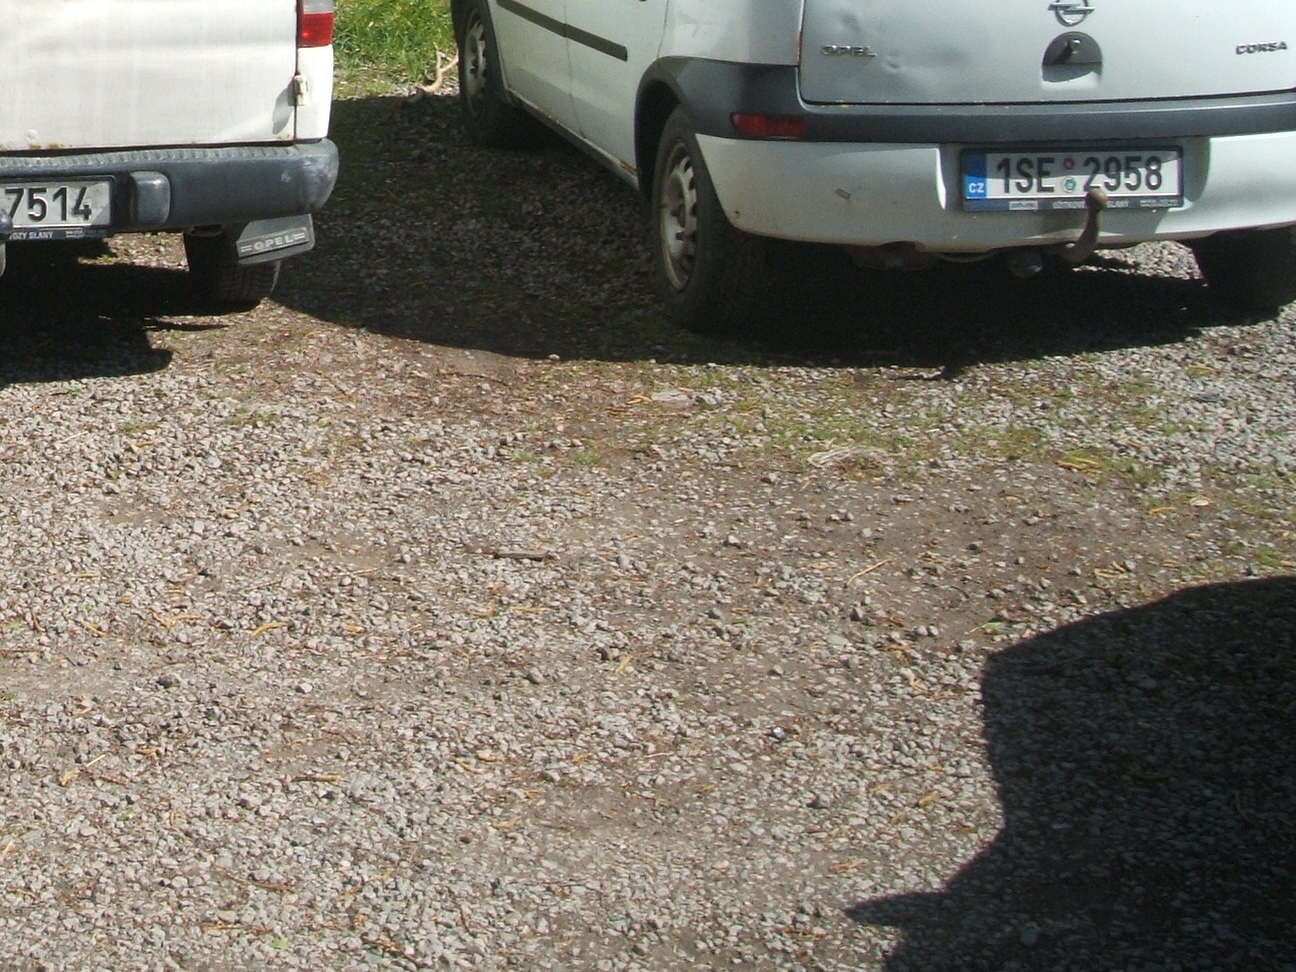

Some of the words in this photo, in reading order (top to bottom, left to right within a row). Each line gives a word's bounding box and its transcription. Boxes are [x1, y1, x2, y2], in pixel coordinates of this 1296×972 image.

[1236, 41, 1288, 55] CORSA
[969, 183, 985, 194] CZ
[997, 157, 1054, 194] 1SE
[1083, 156, 1162, 192] 2958
[4, 186, 92, 222] 7514
[253, 235, 294, 250] OPEL
